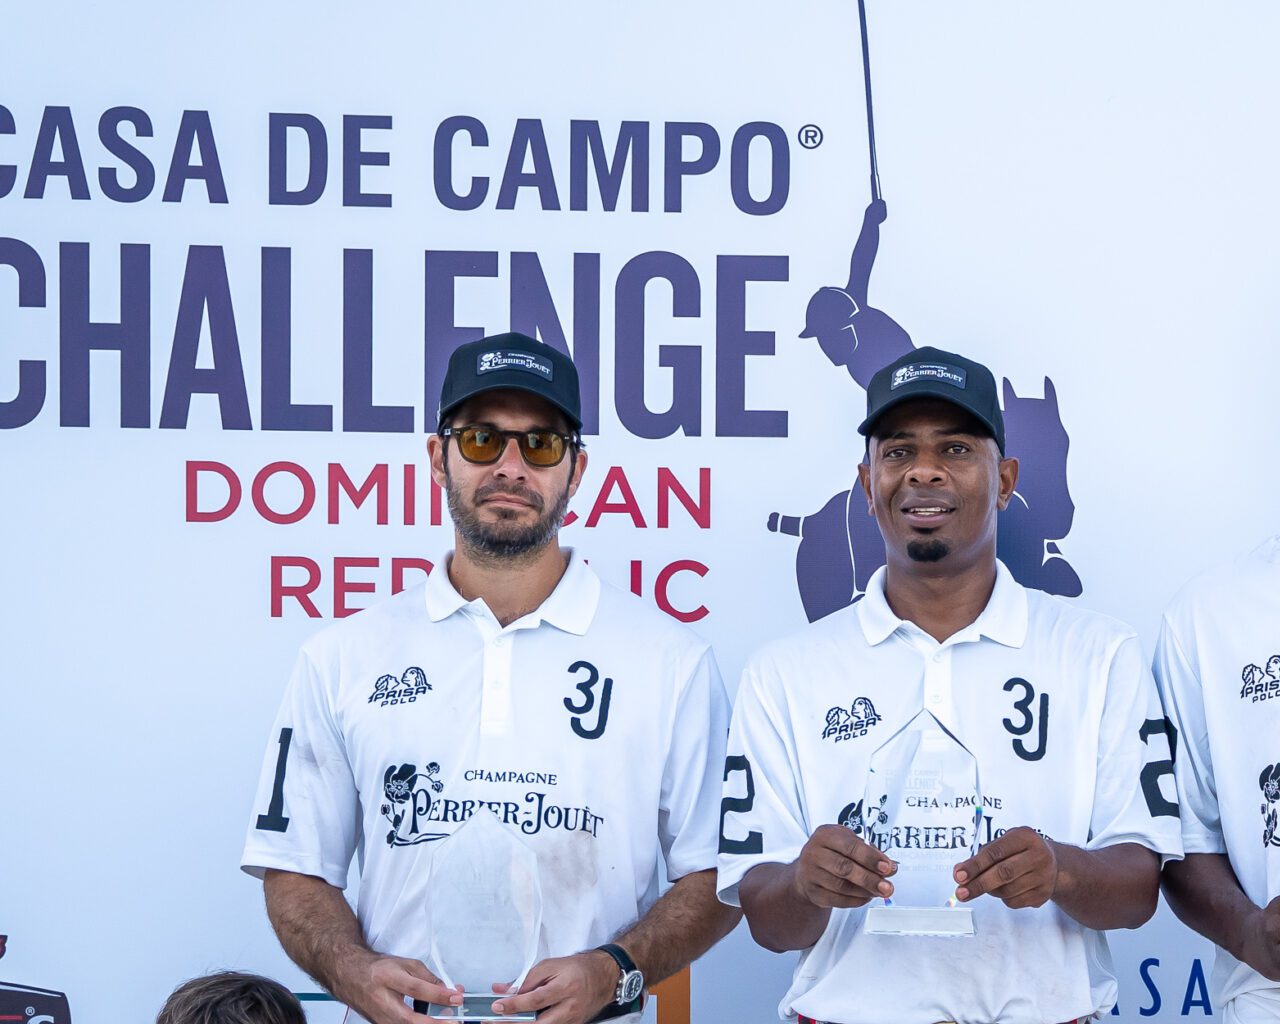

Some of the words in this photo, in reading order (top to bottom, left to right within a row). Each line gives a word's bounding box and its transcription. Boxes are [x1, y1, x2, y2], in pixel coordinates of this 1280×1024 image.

[268, 112, 393, 207] DE
[185, 460, 711, 530] DOMIAN
[270, 556, 710, 624] REPIC
[373, 686, 427, 702] PRISA
[380, 696, 417, 708] POLO
[827, 717, 877, 738] PRISA
[834, 728, 868, 743] POLO
[255, 727, 293, 833] 1
[463, 769, 558, 787] CHAMPAGNE
